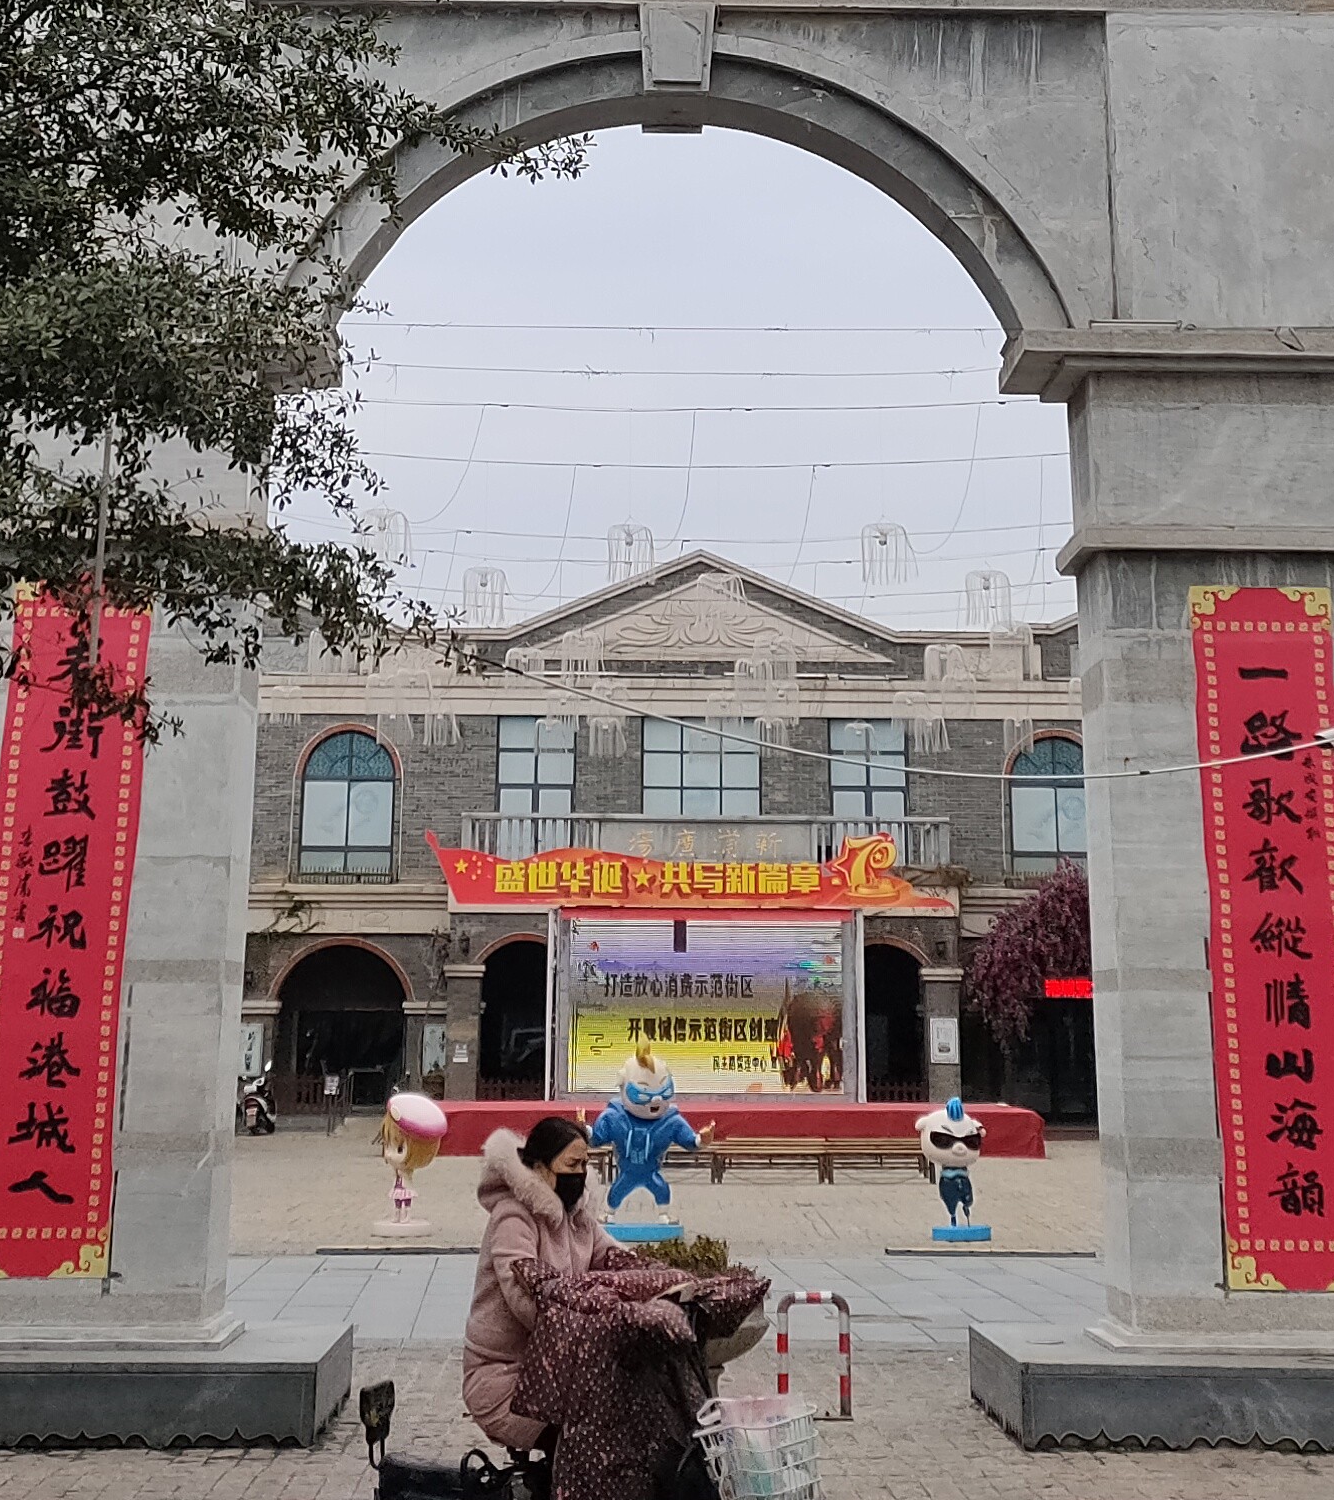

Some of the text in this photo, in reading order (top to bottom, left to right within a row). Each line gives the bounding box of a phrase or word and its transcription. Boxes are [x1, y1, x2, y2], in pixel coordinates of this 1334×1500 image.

[494, 861, 821, 895] 盛世华诞 共写新篇章
[604, 972, 754, 999] 打造放心消费示范街区
